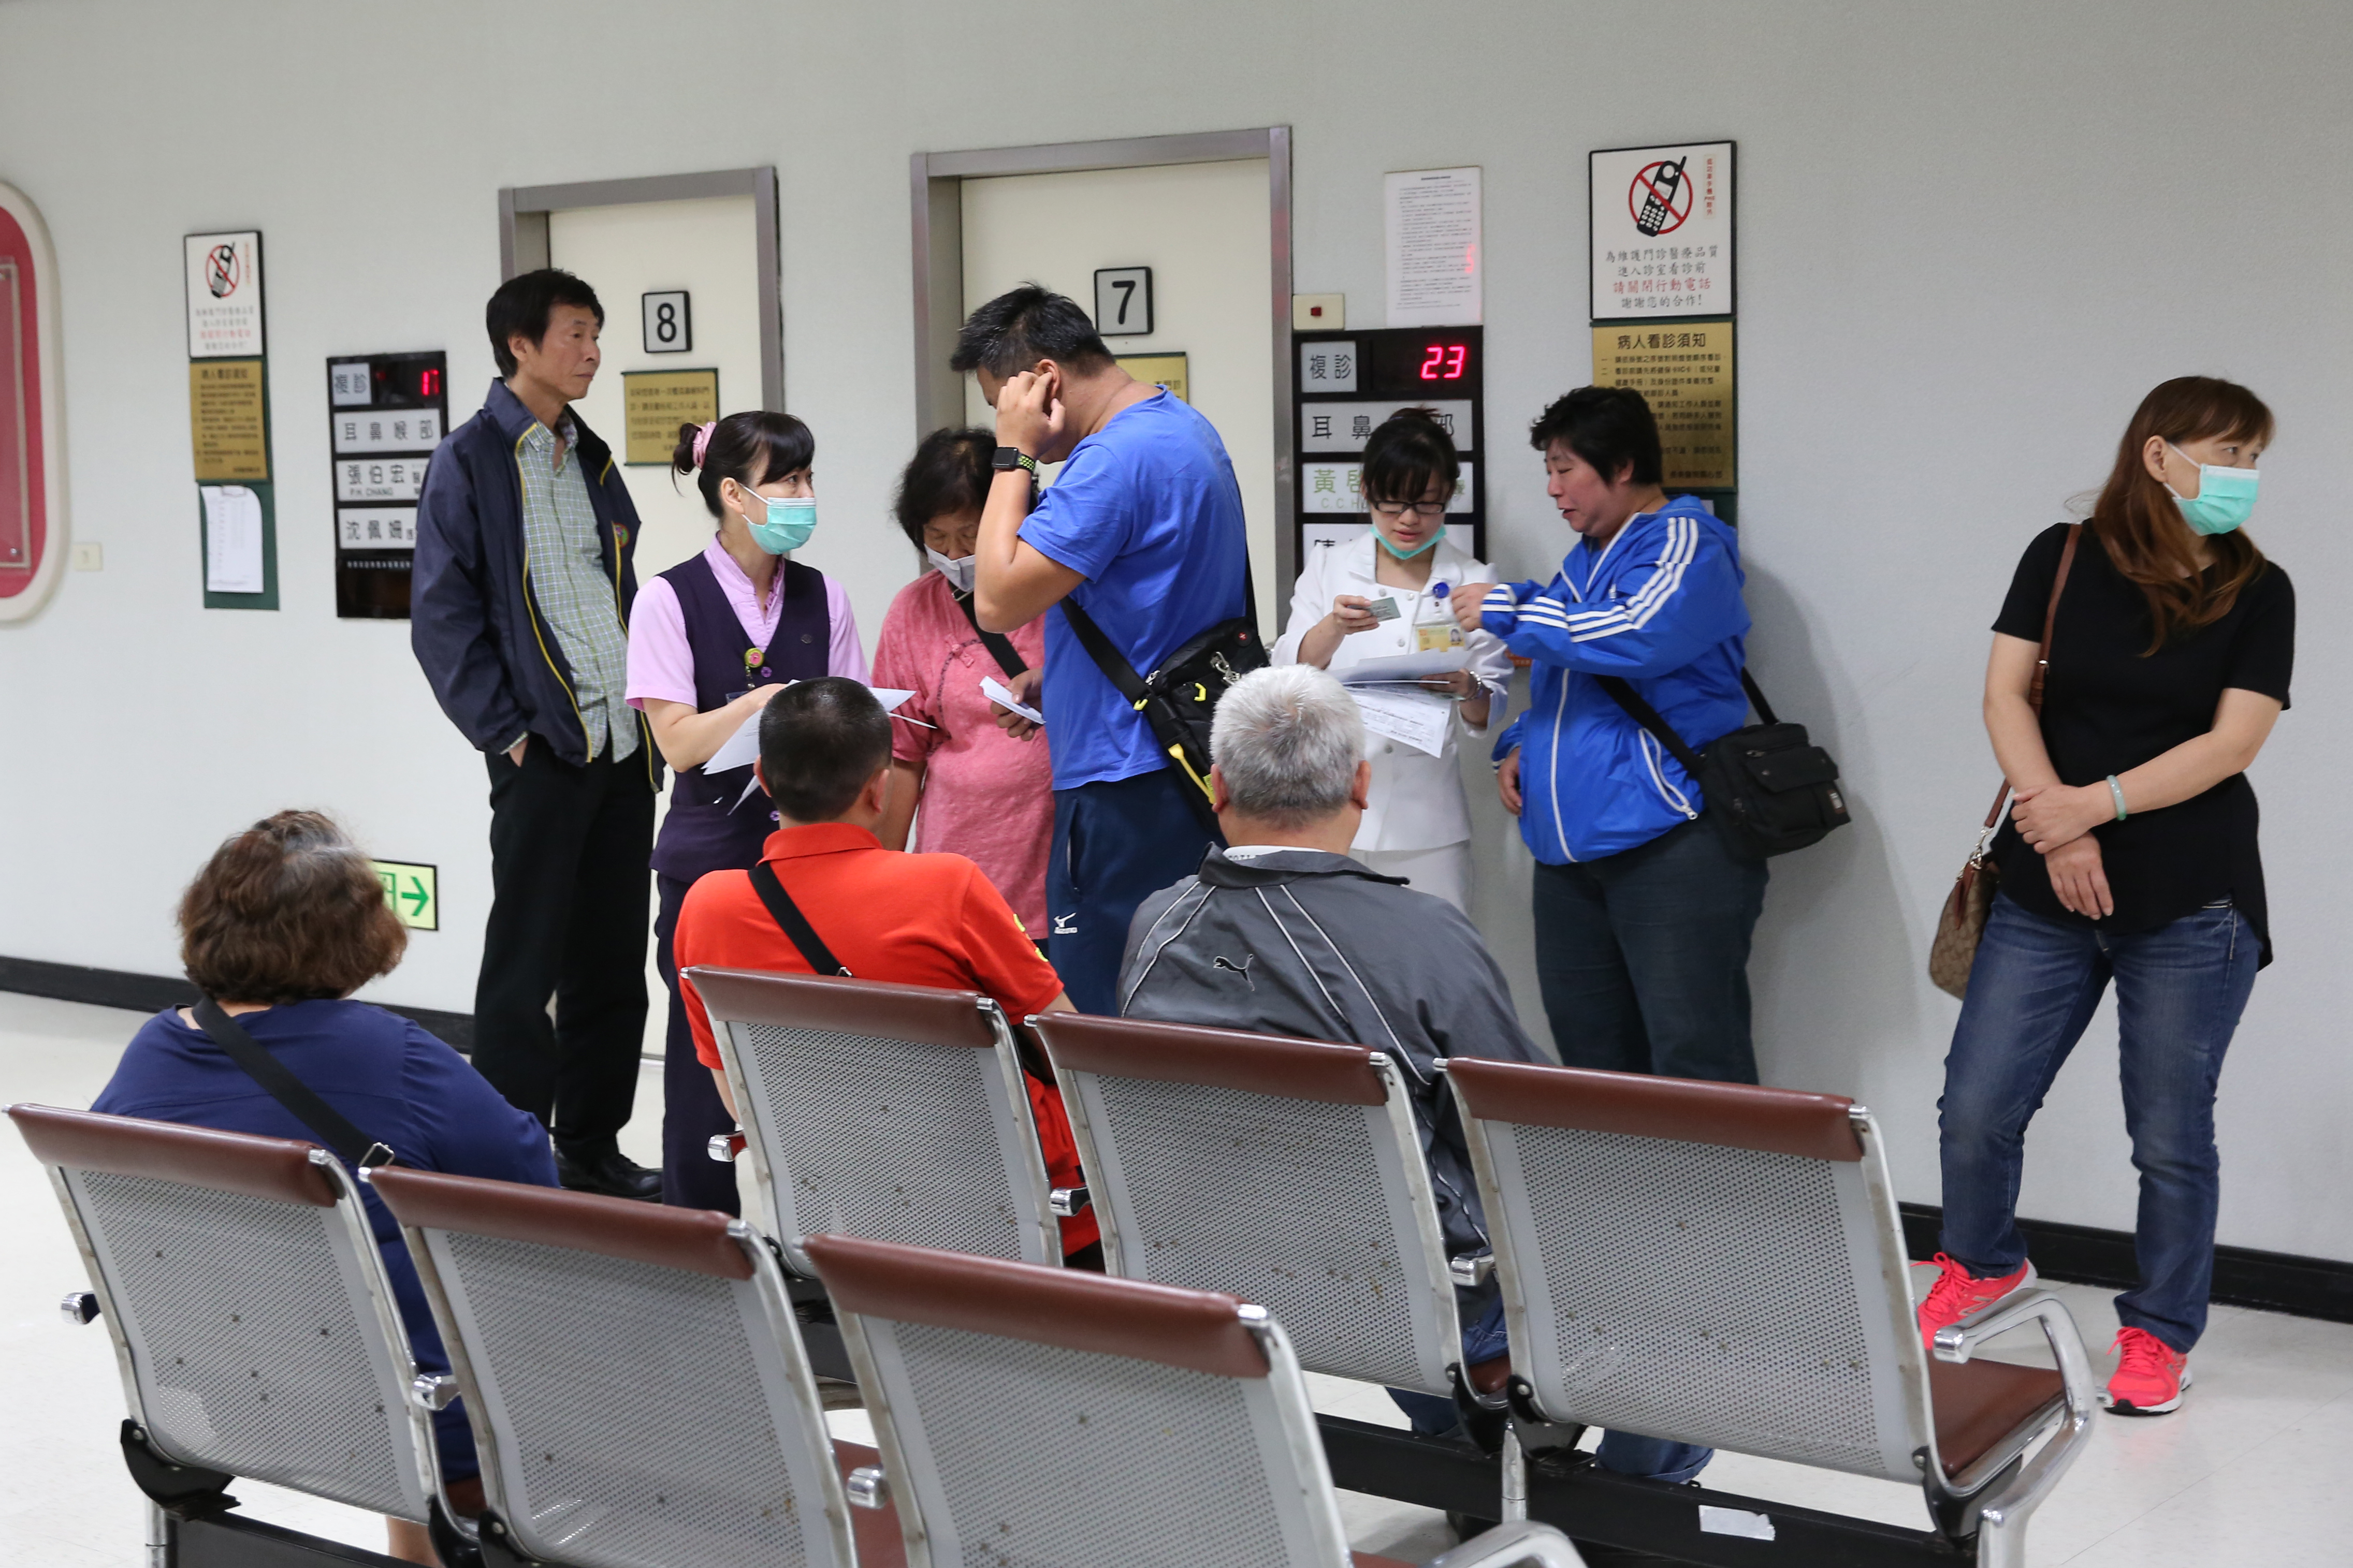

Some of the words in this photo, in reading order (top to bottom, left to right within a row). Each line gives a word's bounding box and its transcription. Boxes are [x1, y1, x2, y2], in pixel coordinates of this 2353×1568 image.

[1606, 244, 1718, 263] 為維護門診醫療品質
[1618, 261, 1707, 277] 進入診室看診前
[1613, 277, 1711, 294] 請關閉行動電話
[1112, 280, 1136, 325] 7
[657, 302, 677, 343] 8
[1617, 333, 1706, 349] 病人看診須知
[1310, 354, 1352, 380] 複診
[1421, 345, 1466, 380] 23
